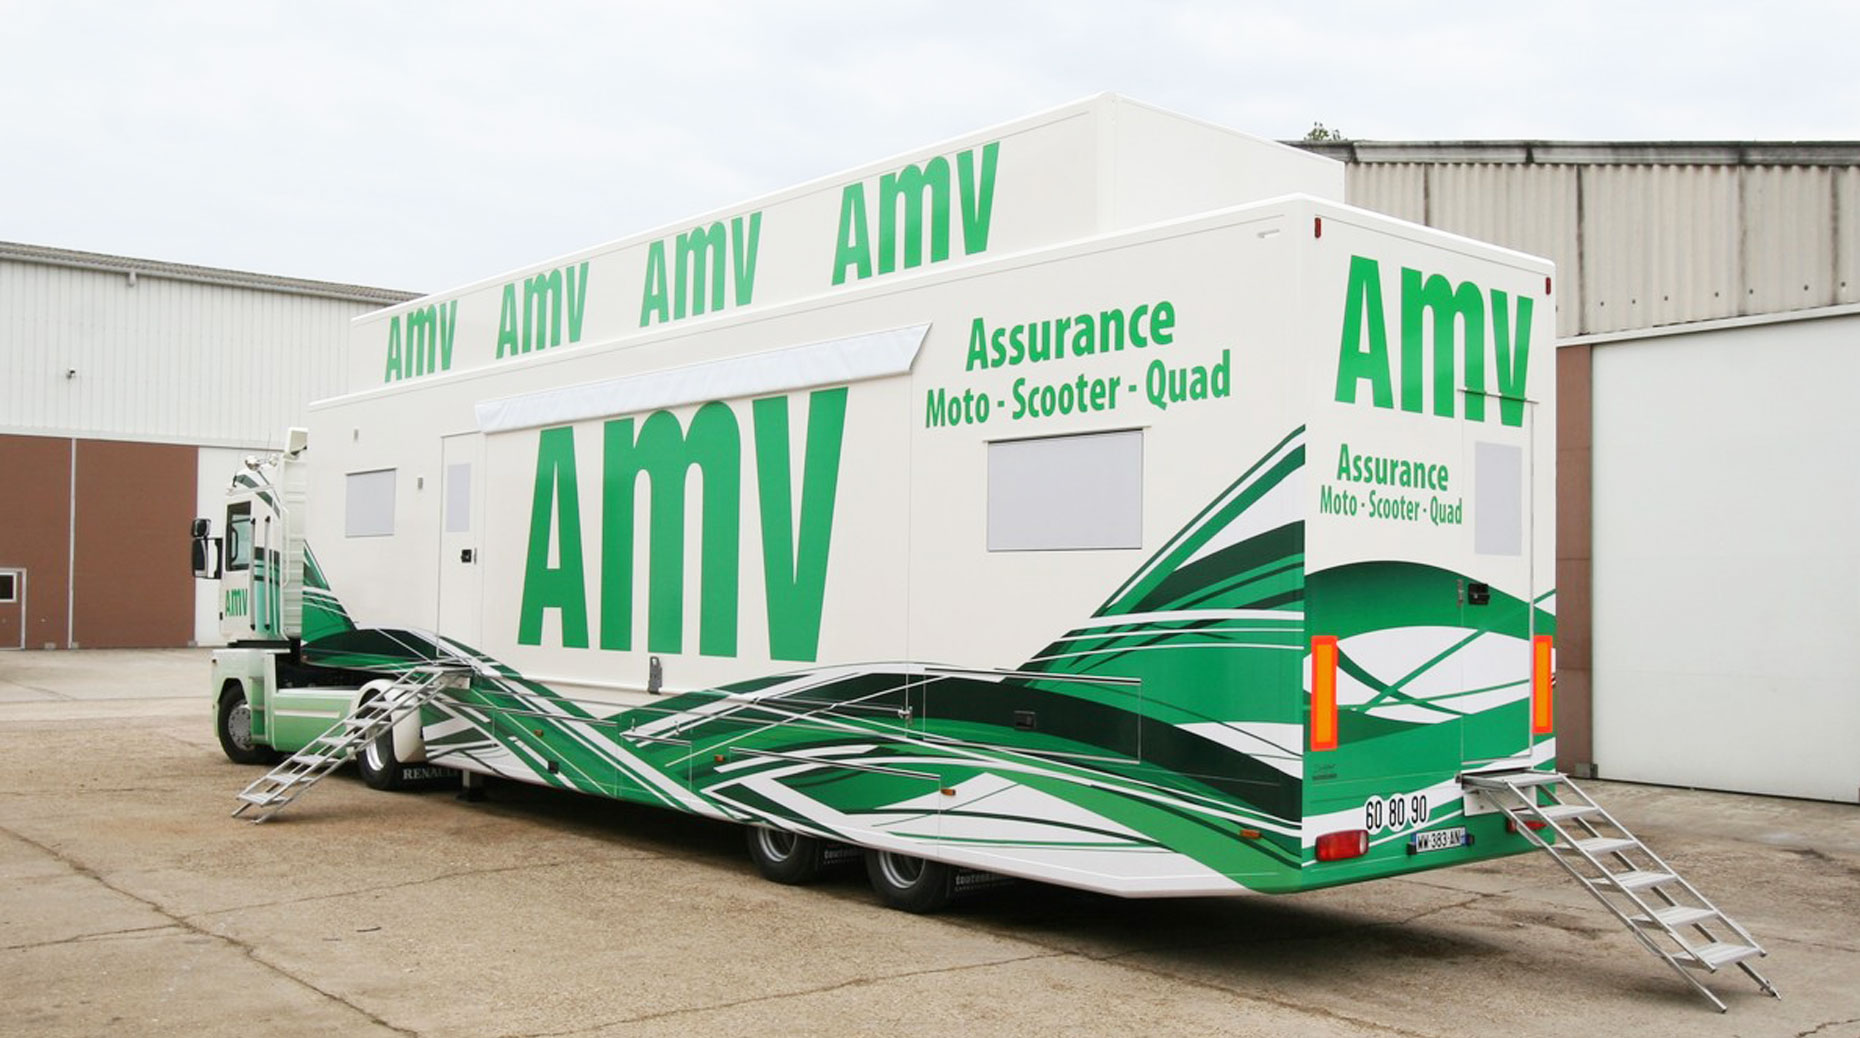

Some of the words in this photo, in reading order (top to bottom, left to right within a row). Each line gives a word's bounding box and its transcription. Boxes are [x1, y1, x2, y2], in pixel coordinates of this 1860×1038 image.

[965, 300, 1176, 372] Assurance
[925, 388, 990, 428] Moto
[1012, 374, 1121, 420] Scooter
[1146, 348, 1231, 411] Quad
[1336, 443, 1449, 491] Assurance
[1320, 484, 1358, 517] Moto
[1368, 489, 1420, 522] Scooter
[1430, 497, 1463, 525] Quad
[1366, 800, 1383, 830] 60
[1389, 798, 1405, 827] 80
[1411, 795, 1427, 823] 90
